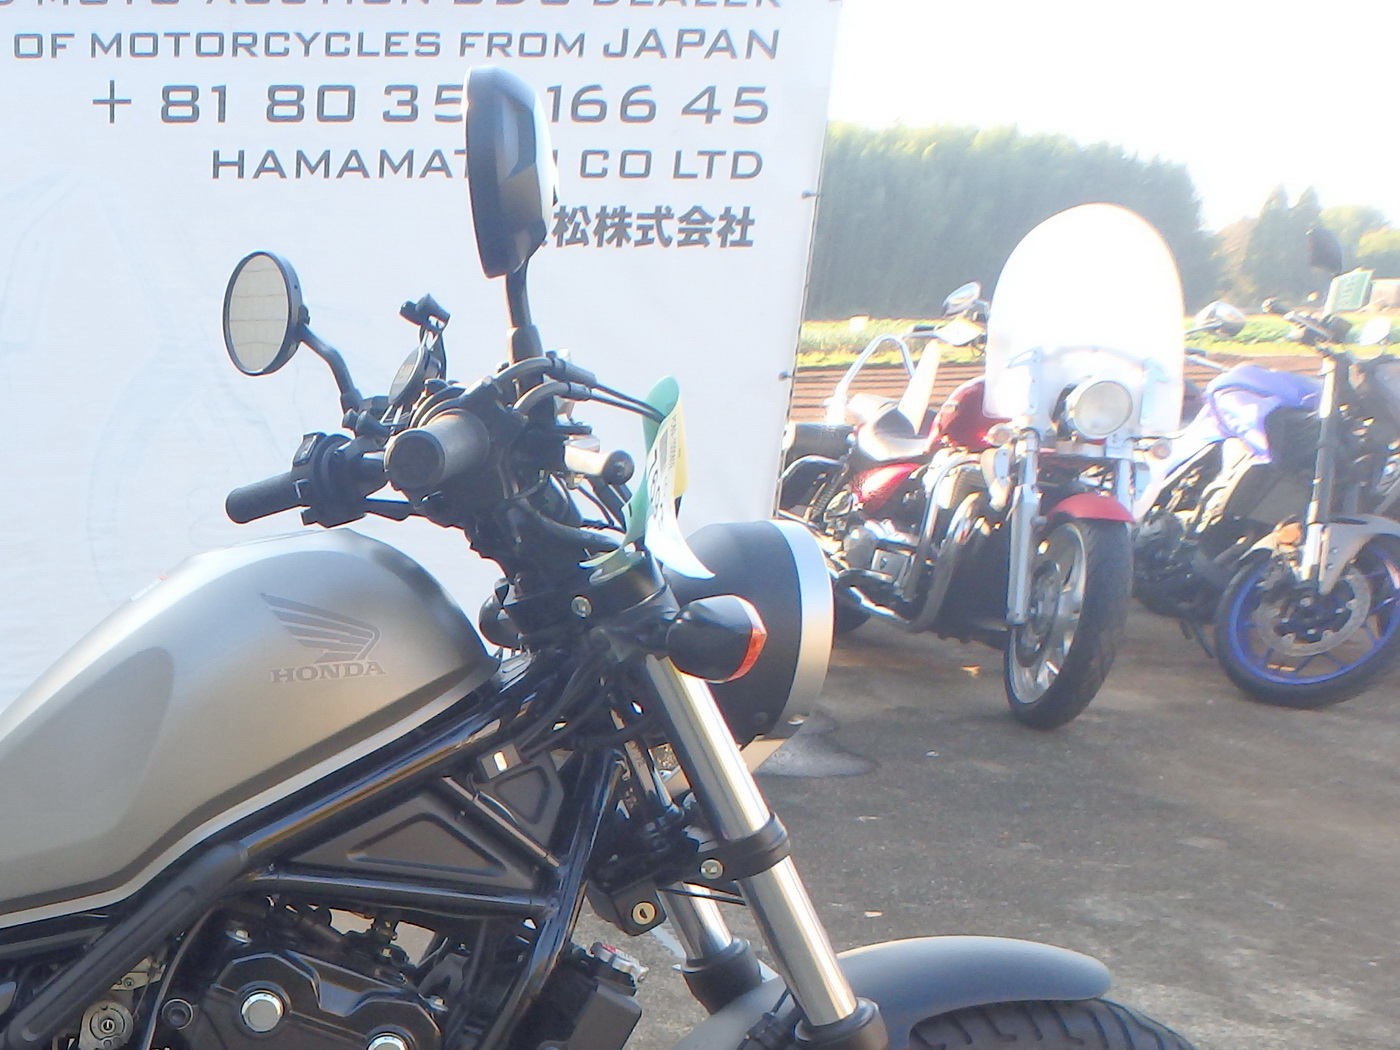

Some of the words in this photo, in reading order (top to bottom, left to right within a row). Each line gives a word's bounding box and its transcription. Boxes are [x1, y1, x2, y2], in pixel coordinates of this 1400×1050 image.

[12, 32, 76, 60] OF
[90, 31, 441, 60] MOTORCYCLES
[458, 31, 586, 59] FROM
[602, 27, 781, 60] JAPAN
[160, 84, 227, 124] 81
[265, 84, 357, 124] 80
[680, 85, 769, 125] 45
[579, 149, 653, 179] CO
[672, 149, 763, 180] LTD
[545, 204, 757, 248] 松株式会社
[269, 660, 389, 684] HONDA
